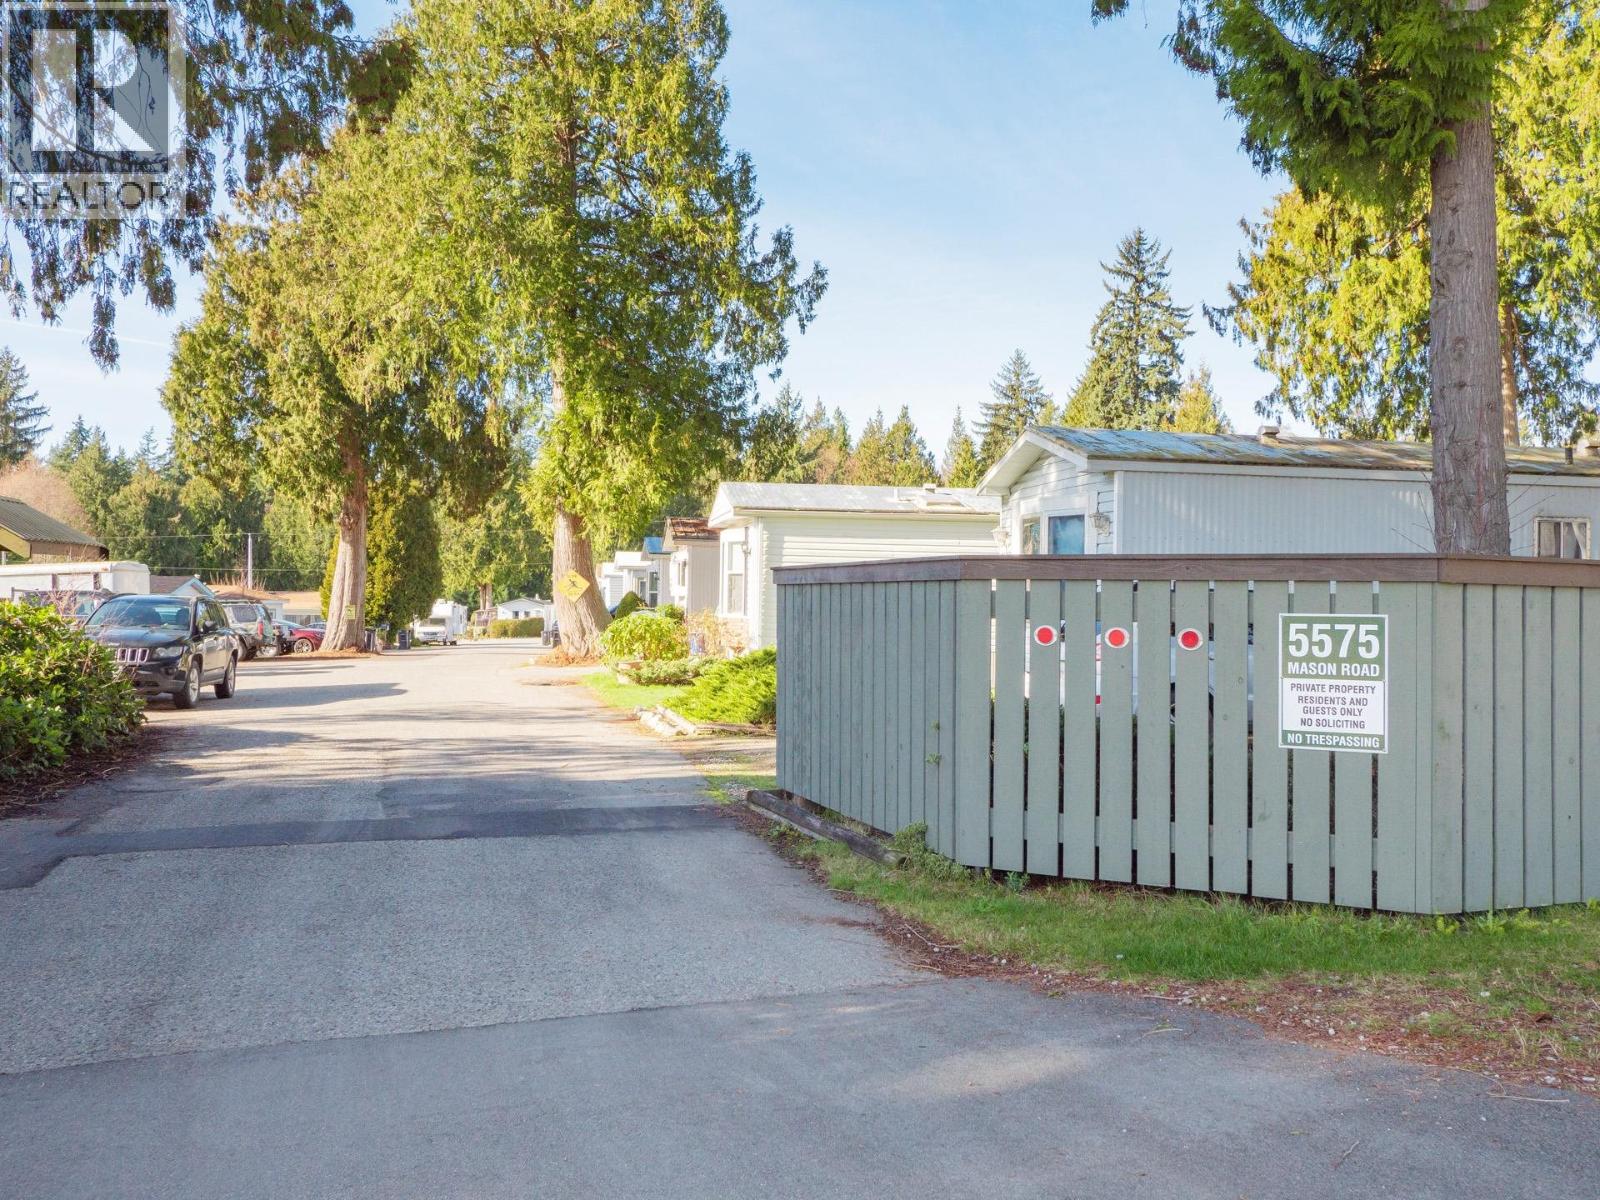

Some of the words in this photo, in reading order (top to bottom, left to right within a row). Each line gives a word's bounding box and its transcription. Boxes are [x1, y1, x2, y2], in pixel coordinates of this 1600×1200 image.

[1288, 623, 1380, 659] 5575
[1287, 662, 1337, 675] MASON
[1341, 664, 1380, 677] ROAD
[1290, 683, 1326, 693] PRIVATE
[1328, 685, 1376, 695] PROPERTY
[1297, 696, 1347, 706] RESIDENTS
[1349, 697, 1368, 707] AND
[1302, 706, 1337, 716] GUESTS
[1340, 707, 1363, 717] ONLY
[1300, 718, 1313, 727] NO
[1315, 718, 1366, 729] SOLICITING
[1287, 733, 1303, 744] NO
[1305, 734, 1380, 748] TRESPASSING
